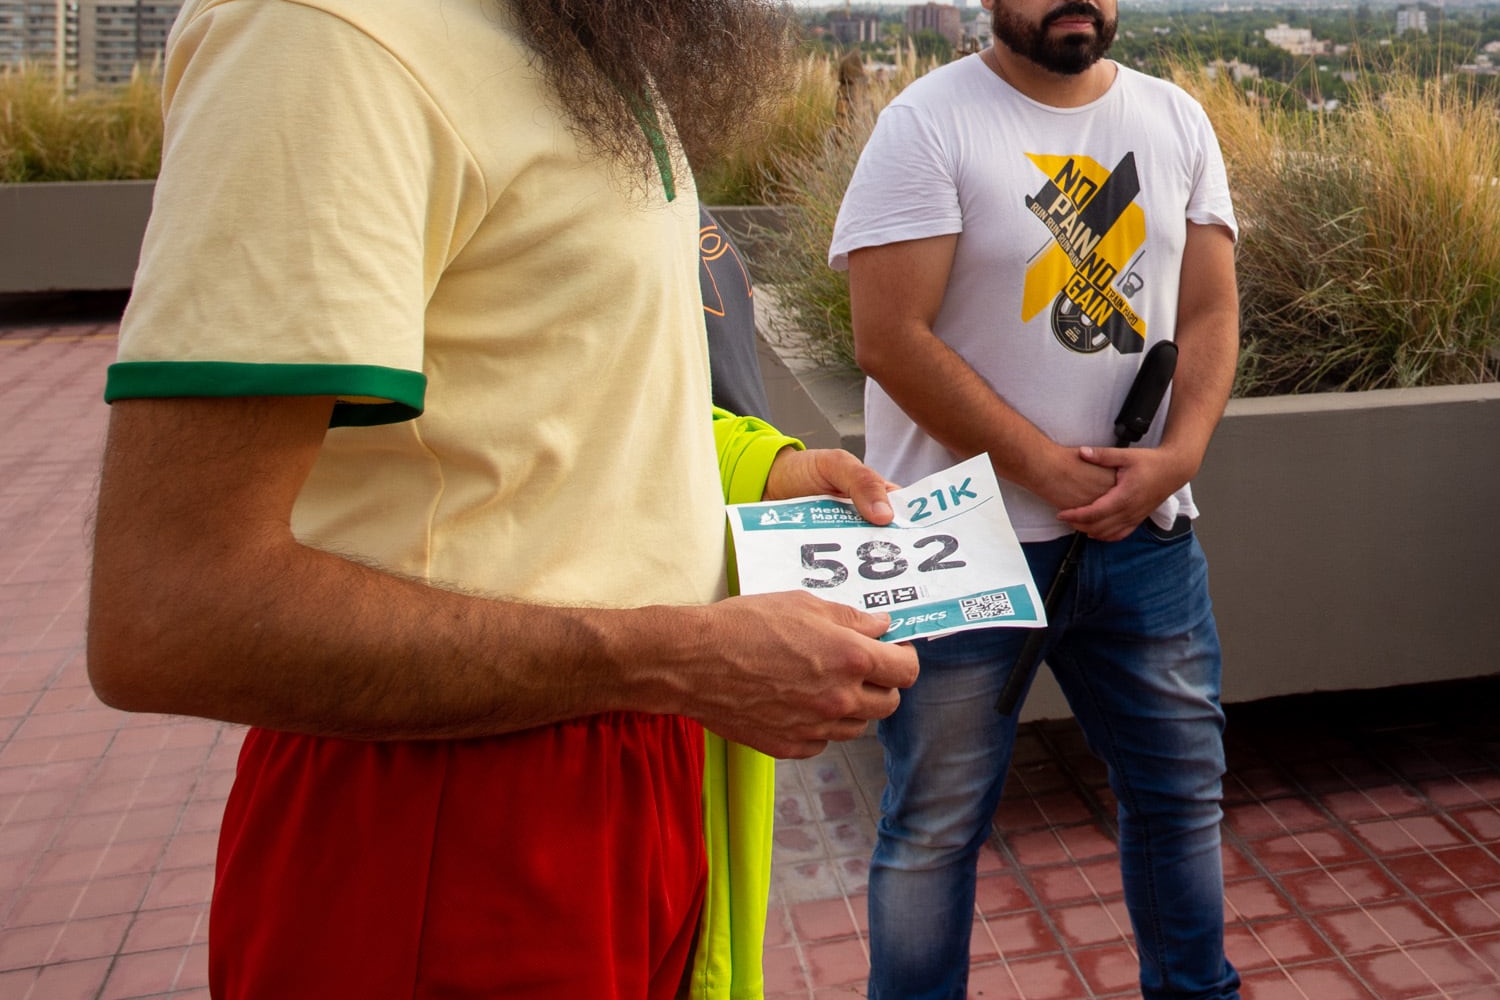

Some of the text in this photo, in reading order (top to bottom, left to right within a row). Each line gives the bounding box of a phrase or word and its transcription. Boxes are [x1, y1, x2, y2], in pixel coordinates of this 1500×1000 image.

[1054, 158, 1098, 209] NO
[1030, 202, 1082, 268] RUN RUN RUN RUN
[1048, 193, 1101, 259] PAIN
[1079, 251, 1117, 290] NO
[1065, 274, 1114, 327] GAIN
[1105, 286, 1126, 310] TRAIN
[810, 507, 853, 515] Media
[907, 477, 978, 522] 21K
[801, 534, 967, 590] 582
